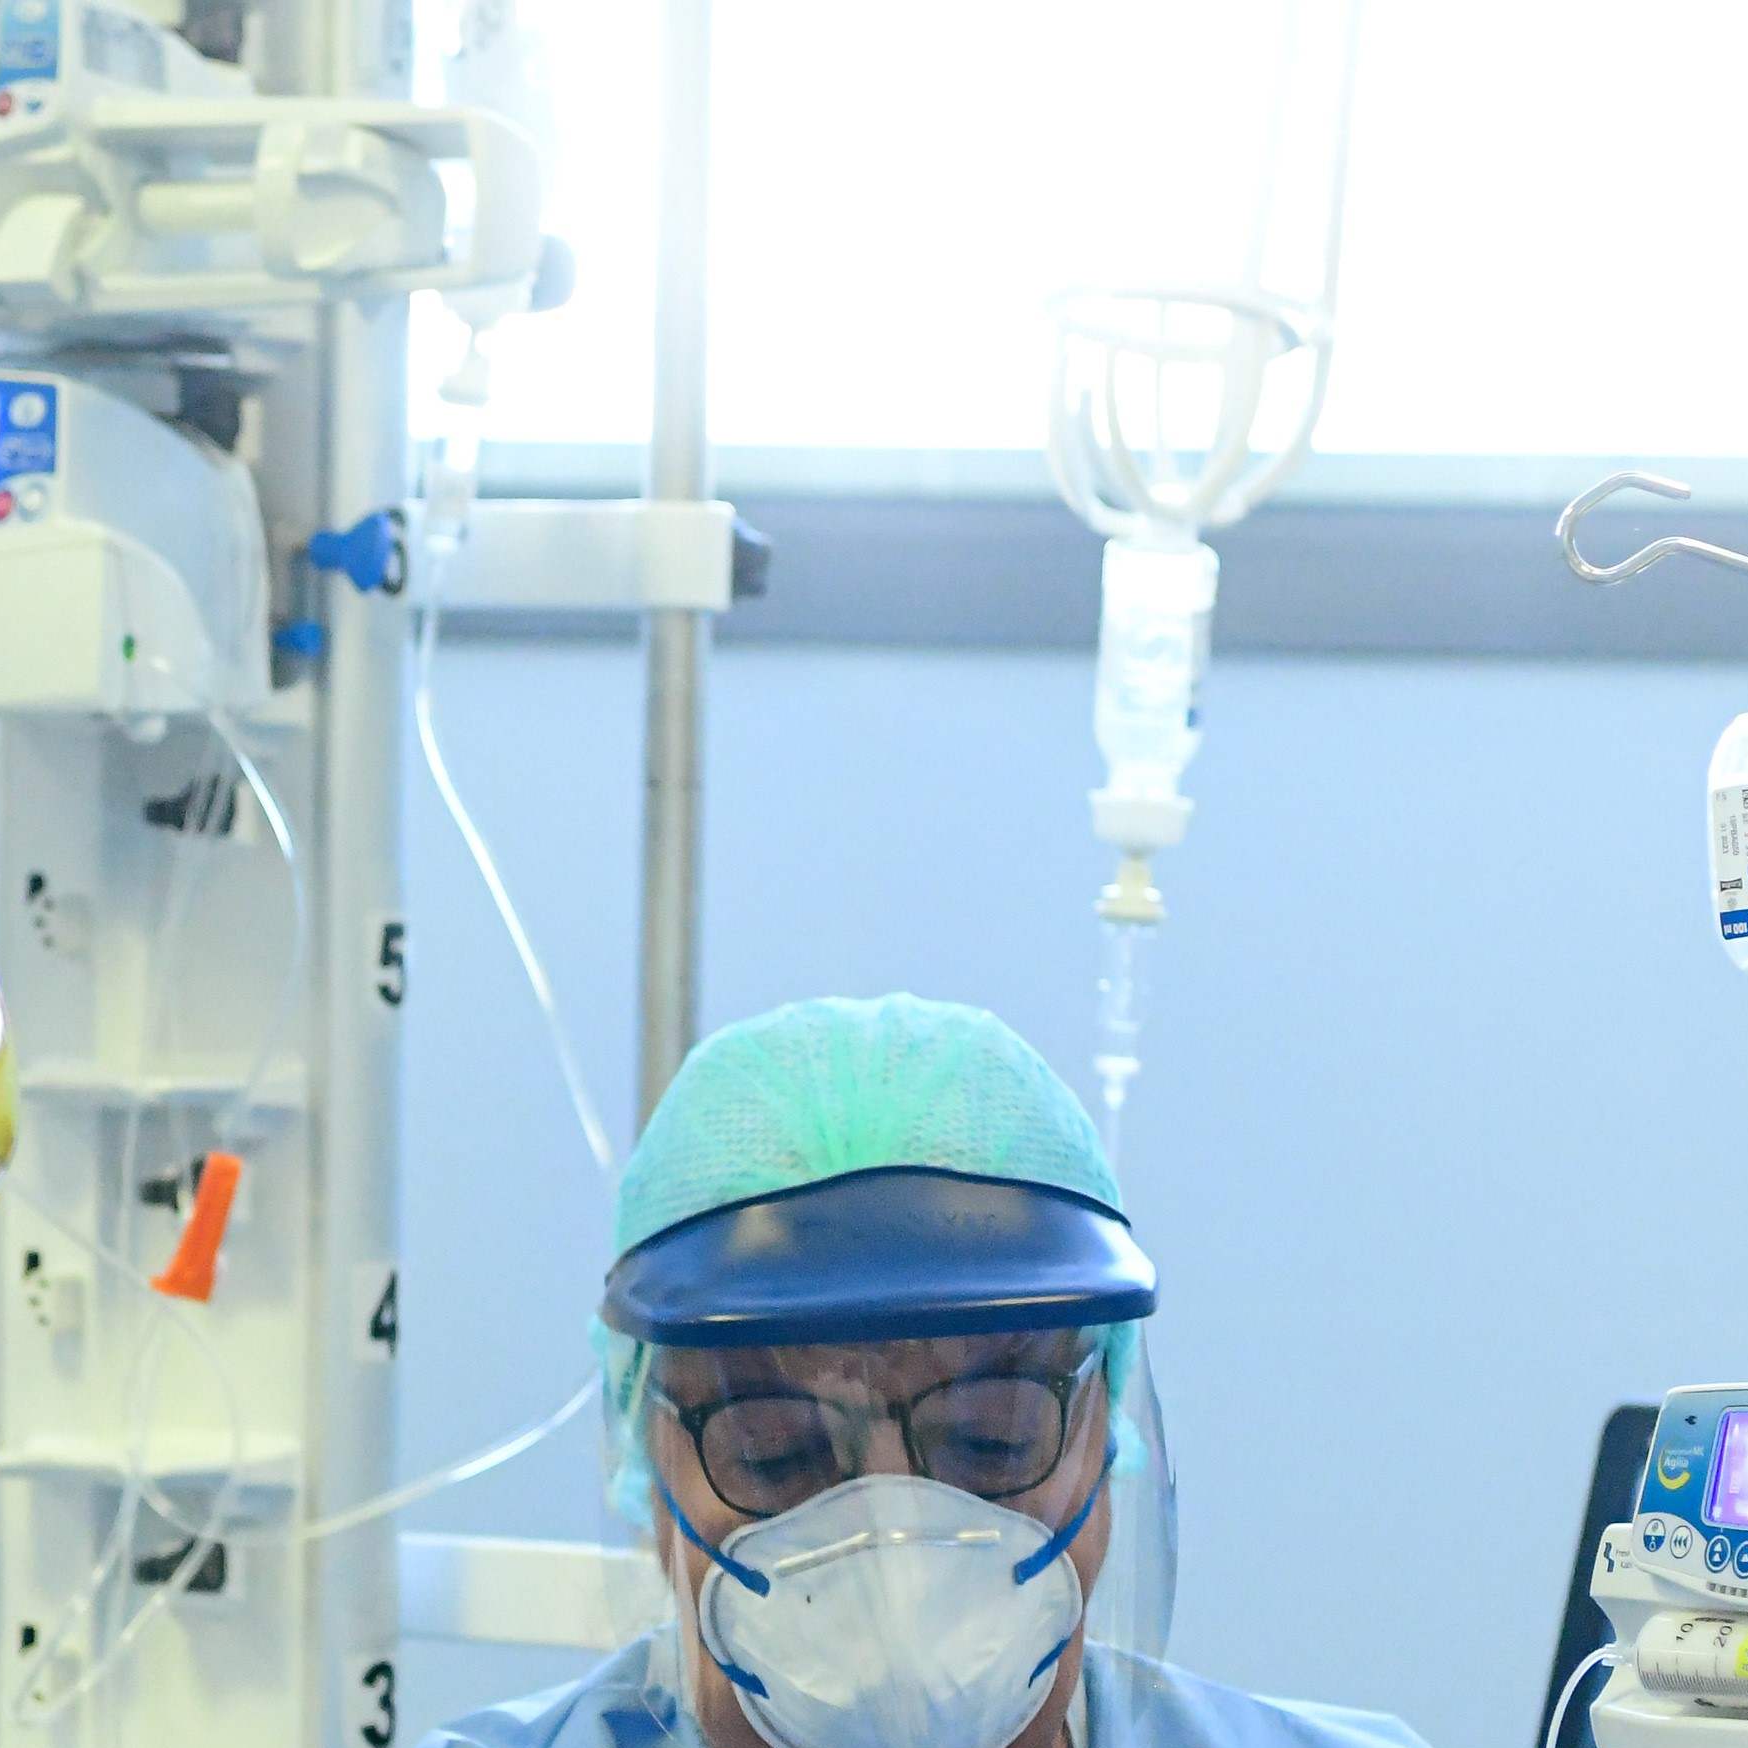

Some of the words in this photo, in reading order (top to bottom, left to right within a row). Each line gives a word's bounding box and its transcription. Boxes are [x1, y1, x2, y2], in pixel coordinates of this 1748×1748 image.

[377, 923, 406, 1007] 5
[369, 1270, 400, 1358] 4
[1676, 1623, 1694, 1641] 10
[1713, 1625, 1733, 1648] 20
